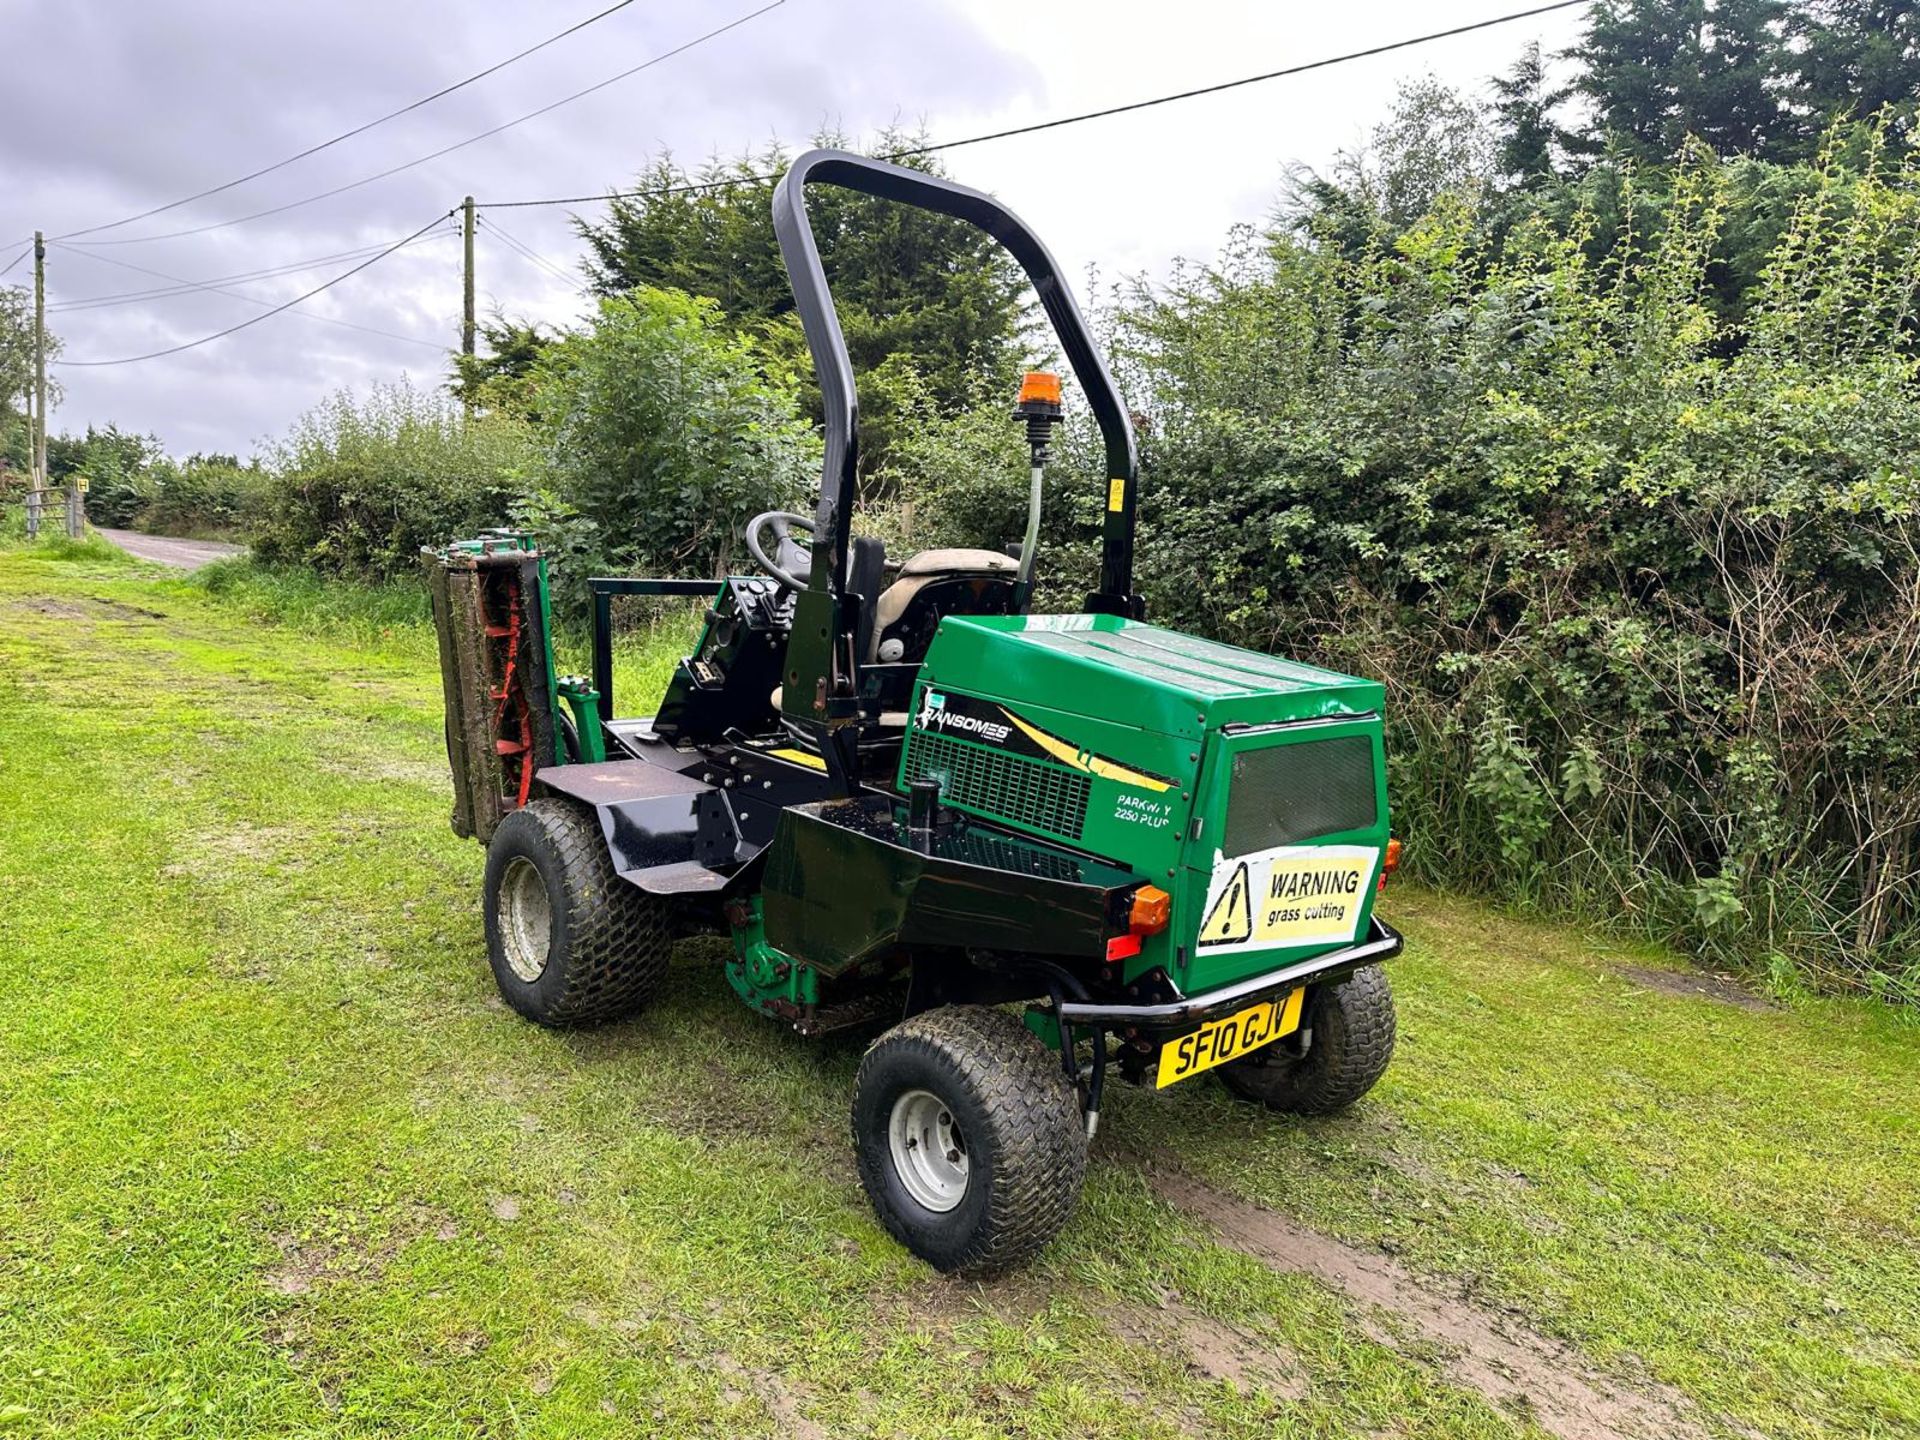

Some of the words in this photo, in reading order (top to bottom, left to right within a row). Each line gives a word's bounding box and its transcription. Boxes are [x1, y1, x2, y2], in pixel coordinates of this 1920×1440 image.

[1114, 807, 1139, 822] 2250
[1117, 795, 1172, 816] PARKWY
[1270, 870, 1359, 899] WARNING
[1267, 908, 1300, 927] grass
[1304, 902, 1345, 922] cutting
[1175, 1021, 1238, 1075] SF10
[1241, 998, 1287, 1048] GJV
